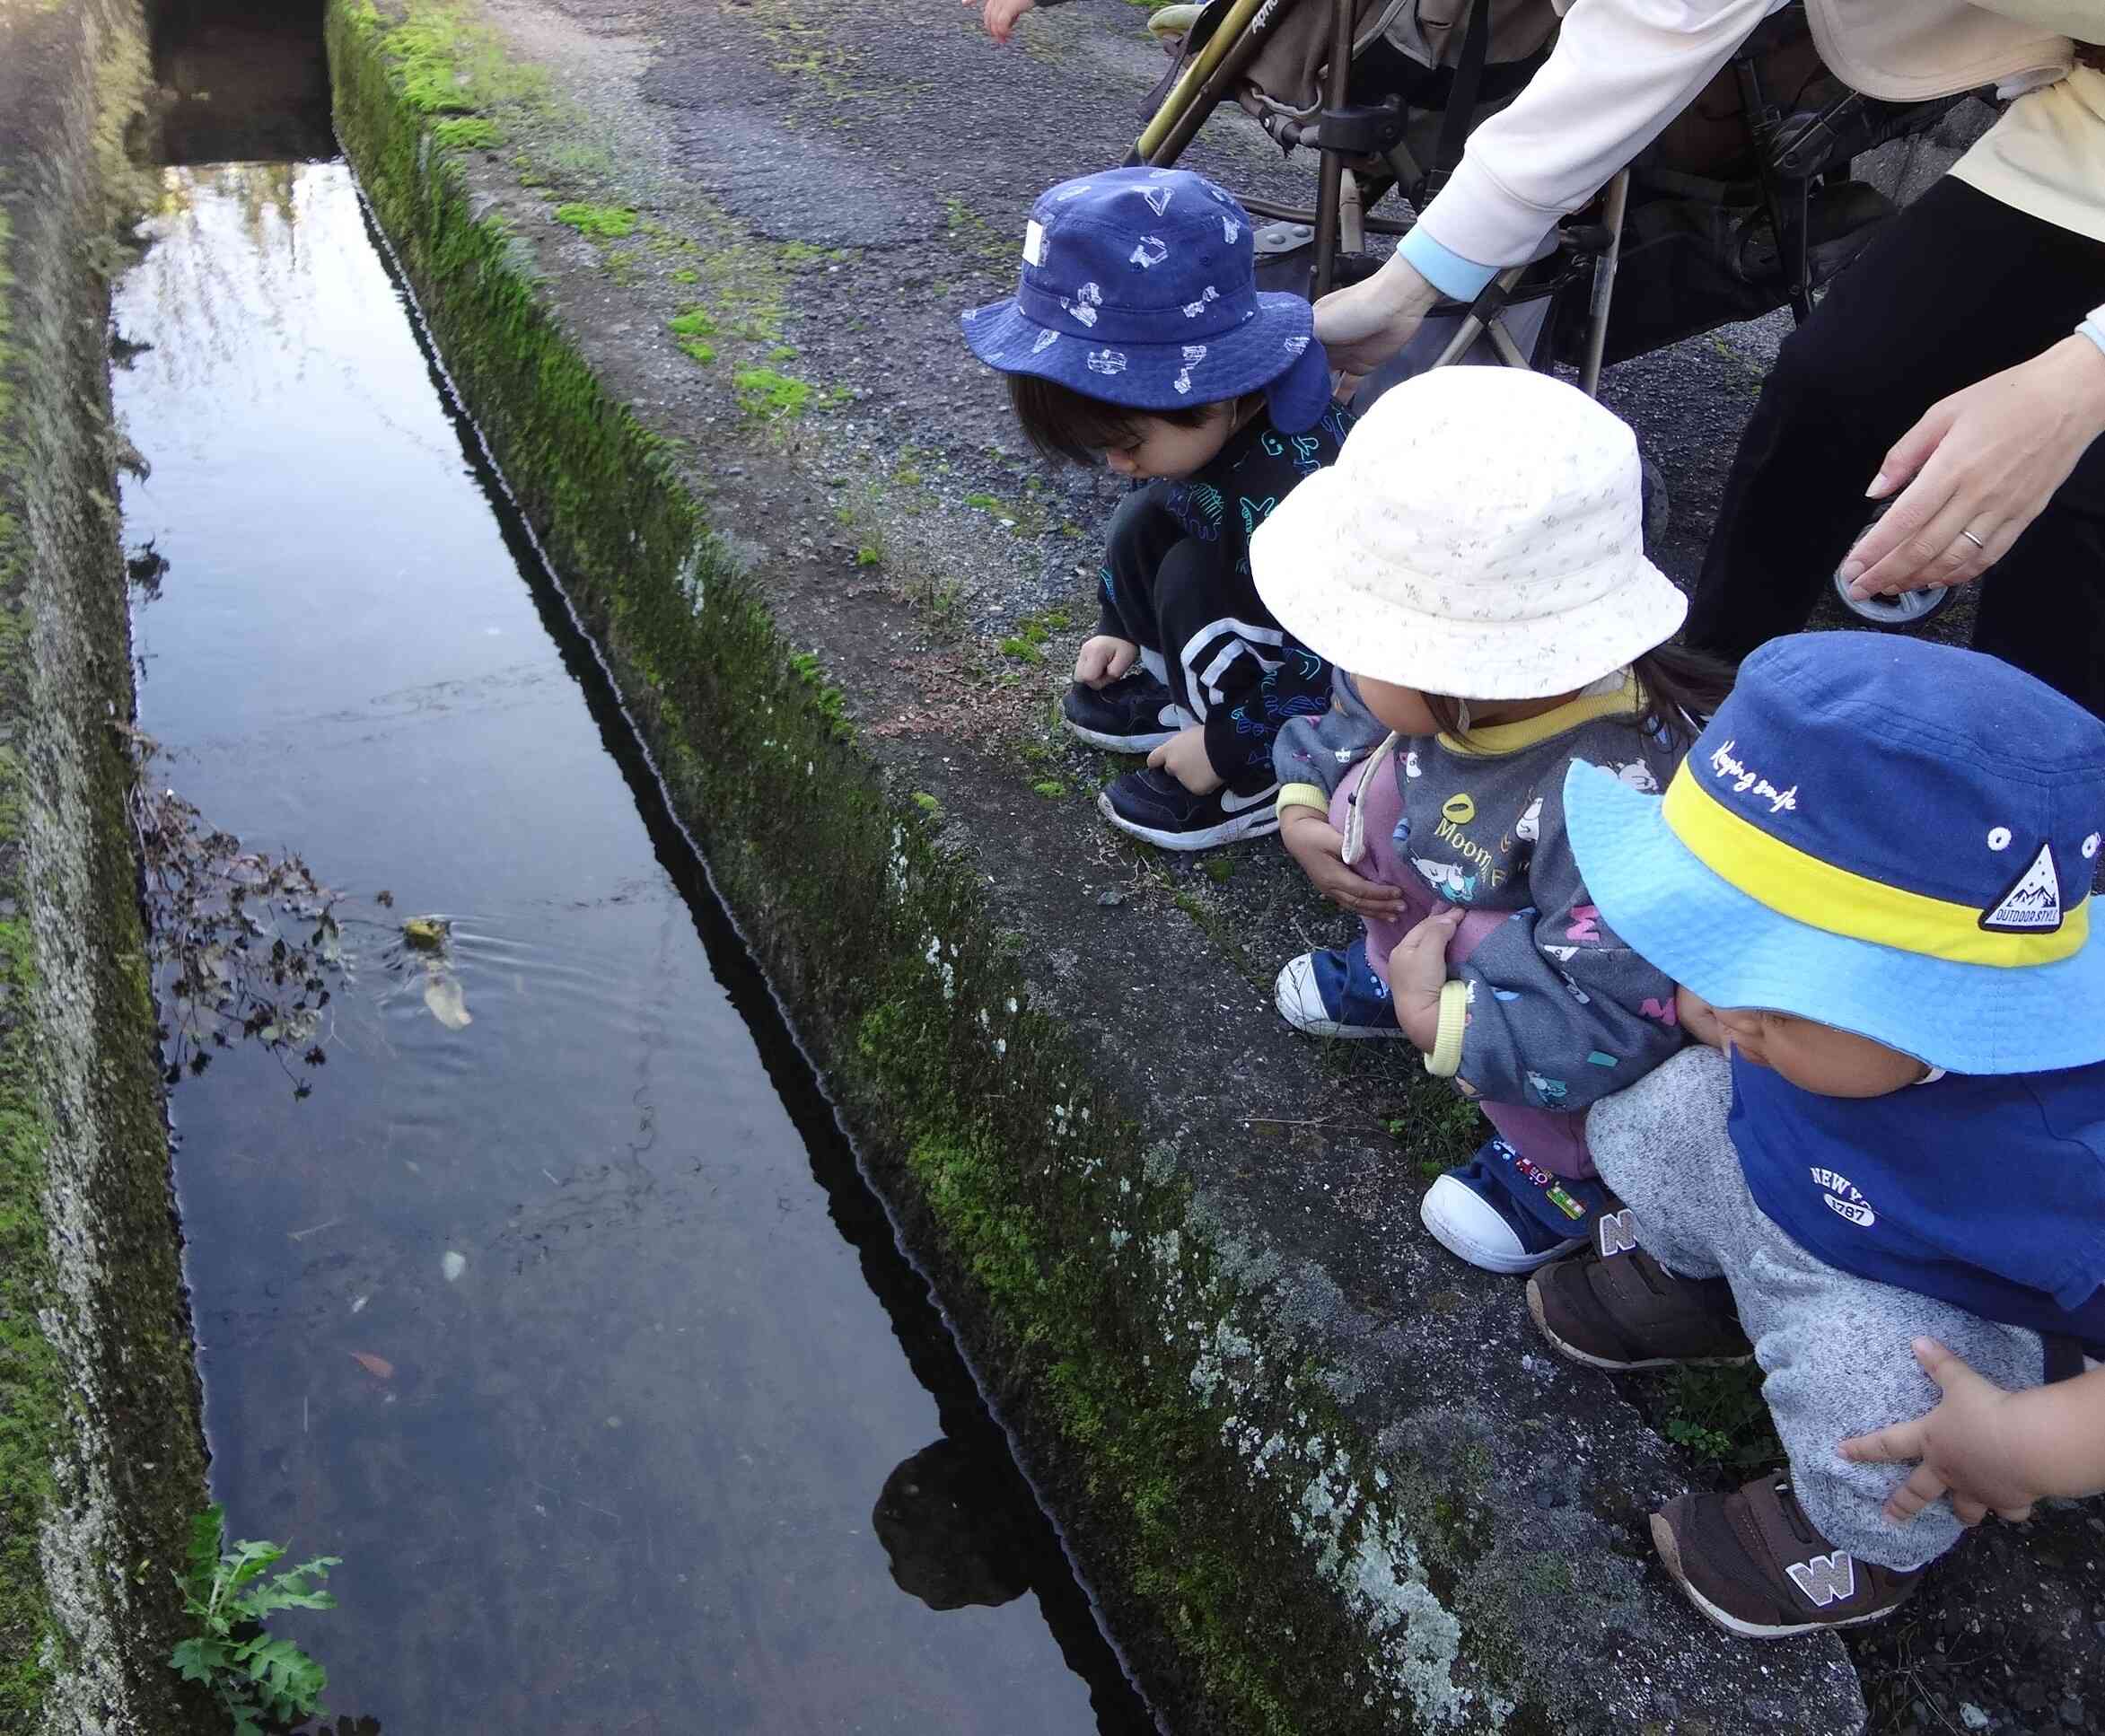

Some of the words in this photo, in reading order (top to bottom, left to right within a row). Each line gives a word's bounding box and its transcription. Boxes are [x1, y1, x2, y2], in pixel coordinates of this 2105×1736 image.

[1995, 908, 2036, 923] OUTDOOR
[1809, 1166, 1852, 1195] NEW
[1831, 1199, 1865, 1222] 1787
